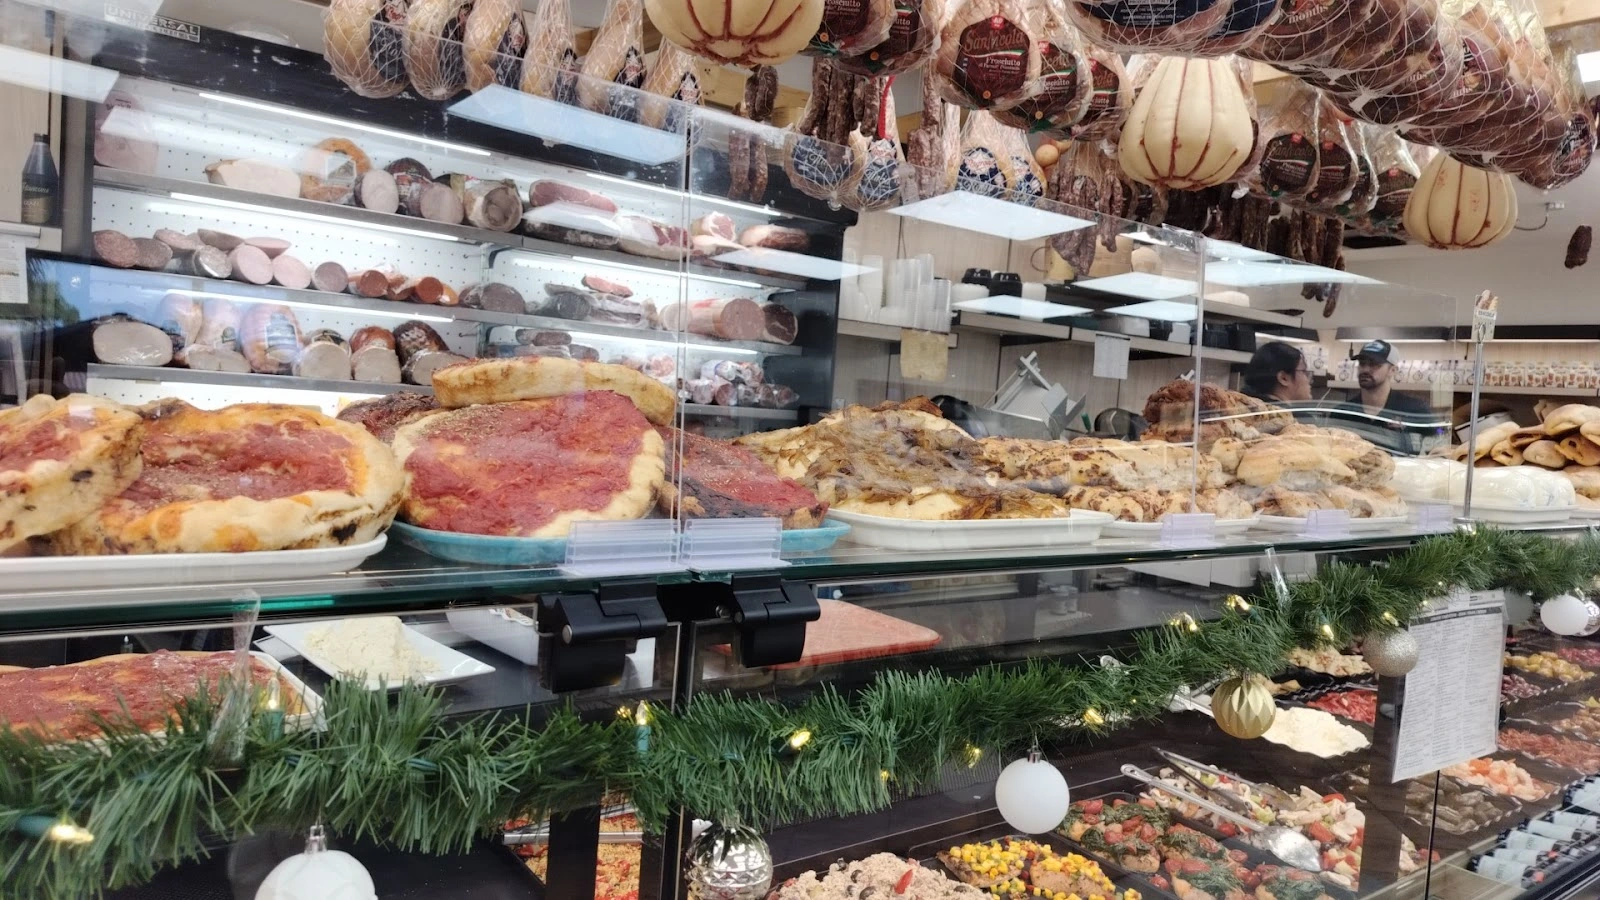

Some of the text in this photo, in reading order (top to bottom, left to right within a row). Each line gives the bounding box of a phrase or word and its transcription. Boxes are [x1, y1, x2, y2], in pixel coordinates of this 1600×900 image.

[106, 6, 197, 35] UNIVERSAL
[1289, 4, 1328, 24] months
[985, 57, 1021, 67] Prosciutto
